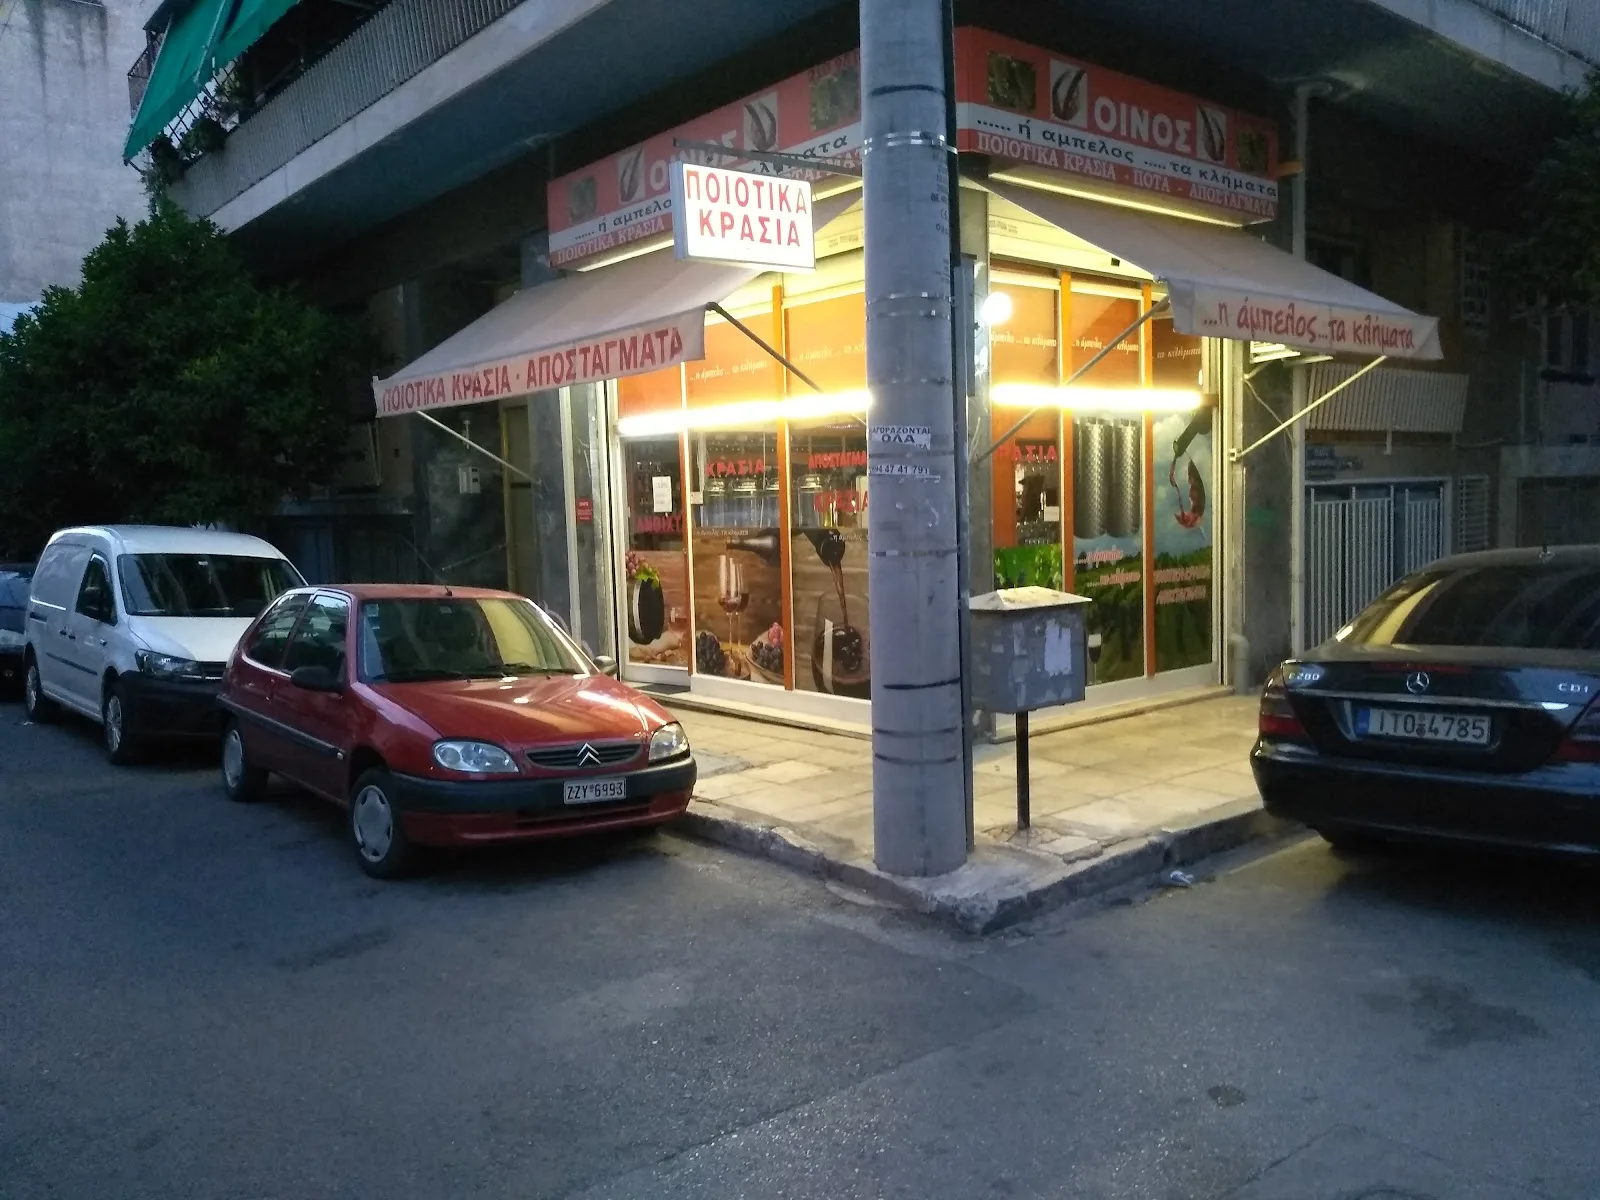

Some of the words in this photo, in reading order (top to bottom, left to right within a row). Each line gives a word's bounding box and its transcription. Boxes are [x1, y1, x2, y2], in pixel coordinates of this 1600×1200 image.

[1094, 96, 1191, 152] ΟΙΝΟΣ
[976, 131, 1060, 168] ΠΟΙΟΤΙΚΑ
[1063, 152, 1117, 180] ΚΡΑΣΙΑ
[1133, 169, 1171, 193] ΠΟΤΑ
[1189, 183, 1275, 217] ΑΠΟΣΤΑΓΜΑΤΑ
[1042, 129, 1134, 163] αμπελος
[1199, 169, 1276, 197] κλήματα
[686, 169, 808, 215] ΠΟΙΟΤΙΚΑ
[613, 199, 672, 227] αμπελο
[699, 208, 801, 248] ΚΡΑΣΙΑ
[557, 232, 616, 263] ΠΟΙΟΤΙΚΑ
[617, 217, 665, 245] ΚΡΑΣΙΑ
[1352, 314, 1415, 350] κλήματα
[382, 376, 446, 413] ΠΟΙΟΤΙΚΑ
[452, 365, 512, 401] ΚΡΑΣΙΑ
[526, 326, 684, 390] ΑΠΟΣΤΑΓΜΑΤΑ
[881, 433, 915, 444] ΟΛΑ
[705, 459, 765, 478] ΚΡΑΣΙΑ
[884, 465, 895, 474] 47
[897, 465, 908, 474] 41
[1557, 682, 1588, 693] CDI
[1427, 716, 1486, 741] 4785
[594, 782, 623, 798] 6993
